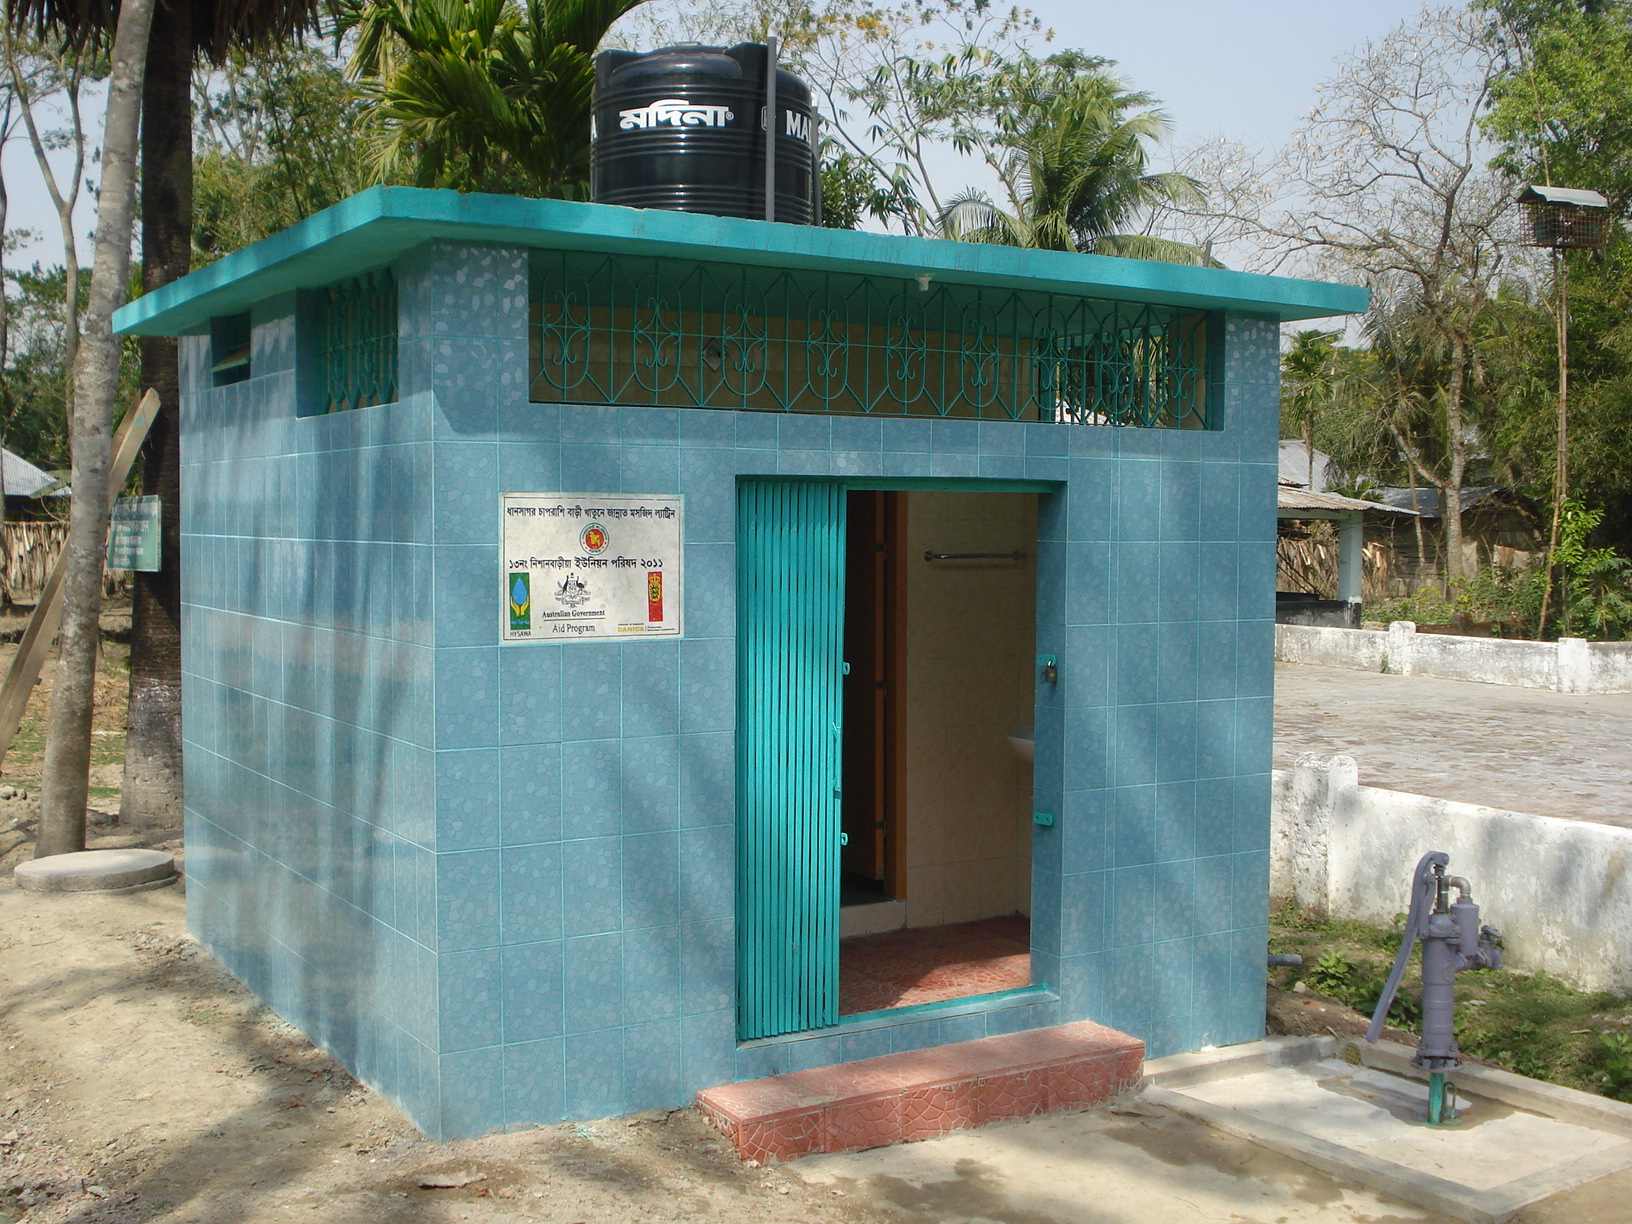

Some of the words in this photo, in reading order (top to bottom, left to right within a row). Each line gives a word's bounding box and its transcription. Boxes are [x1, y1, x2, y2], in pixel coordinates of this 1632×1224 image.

[785, 109, 811, 145] MA
[629, 506, 653, 518] মসজিদ
[574, 556, 608, 569] ইউনিয়ন
[611, 556, 637, 568] পরিষদ
[640, 558, 663, 569] ২০১১
[542, 610, 570, 618] Australian
[571, 609, 605, 617] Government
[552, 624, 565, 633] Aid
[566, 624, 595, 634] Program
